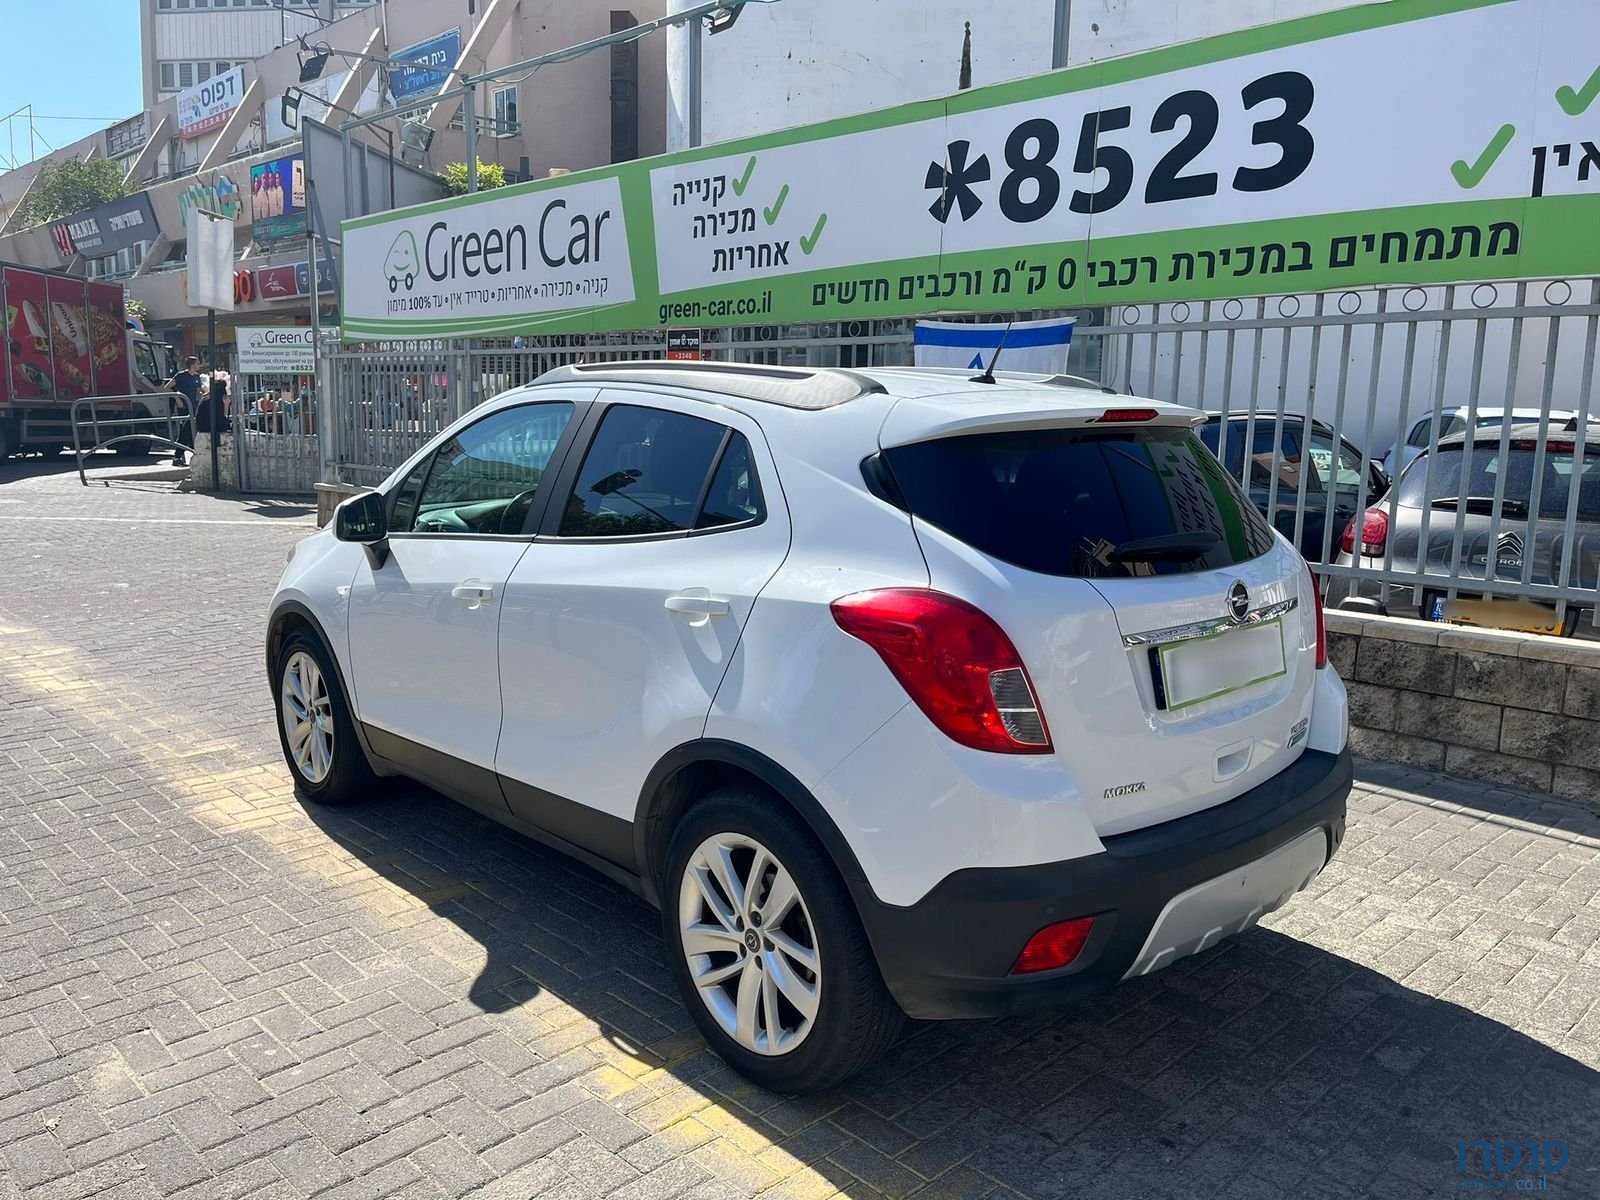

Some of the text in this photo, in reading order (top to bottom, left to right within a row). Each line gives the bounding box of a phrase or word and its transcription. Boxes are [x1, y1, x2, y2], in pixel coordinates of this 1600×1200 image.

[200, 75, 234, 108] דפוס
[672, 175, 726, 208] קנייה
[692, 207, 757, 239] מכירה
[424, 198, 611, 283] Green Car
[711, 240, 790, 273] אחריות
[1328, 221, 1520, 269] מתמחים
[1087, 255, 1158, 288] רכבי
[1167, 240, 1314, 282] במכירת
[387, 277, 609, 316] קניה מכירה אחריות טרייד אין עד 100% מימון
[812, 277, 890, 307] חדשים
[898, 267, 982, 301] ורכבים
[658, 291, 773, 325] green-car.co.il
[265, 330, 302, 344] Green
[1104, 781, 1147, 799] MOKKA
